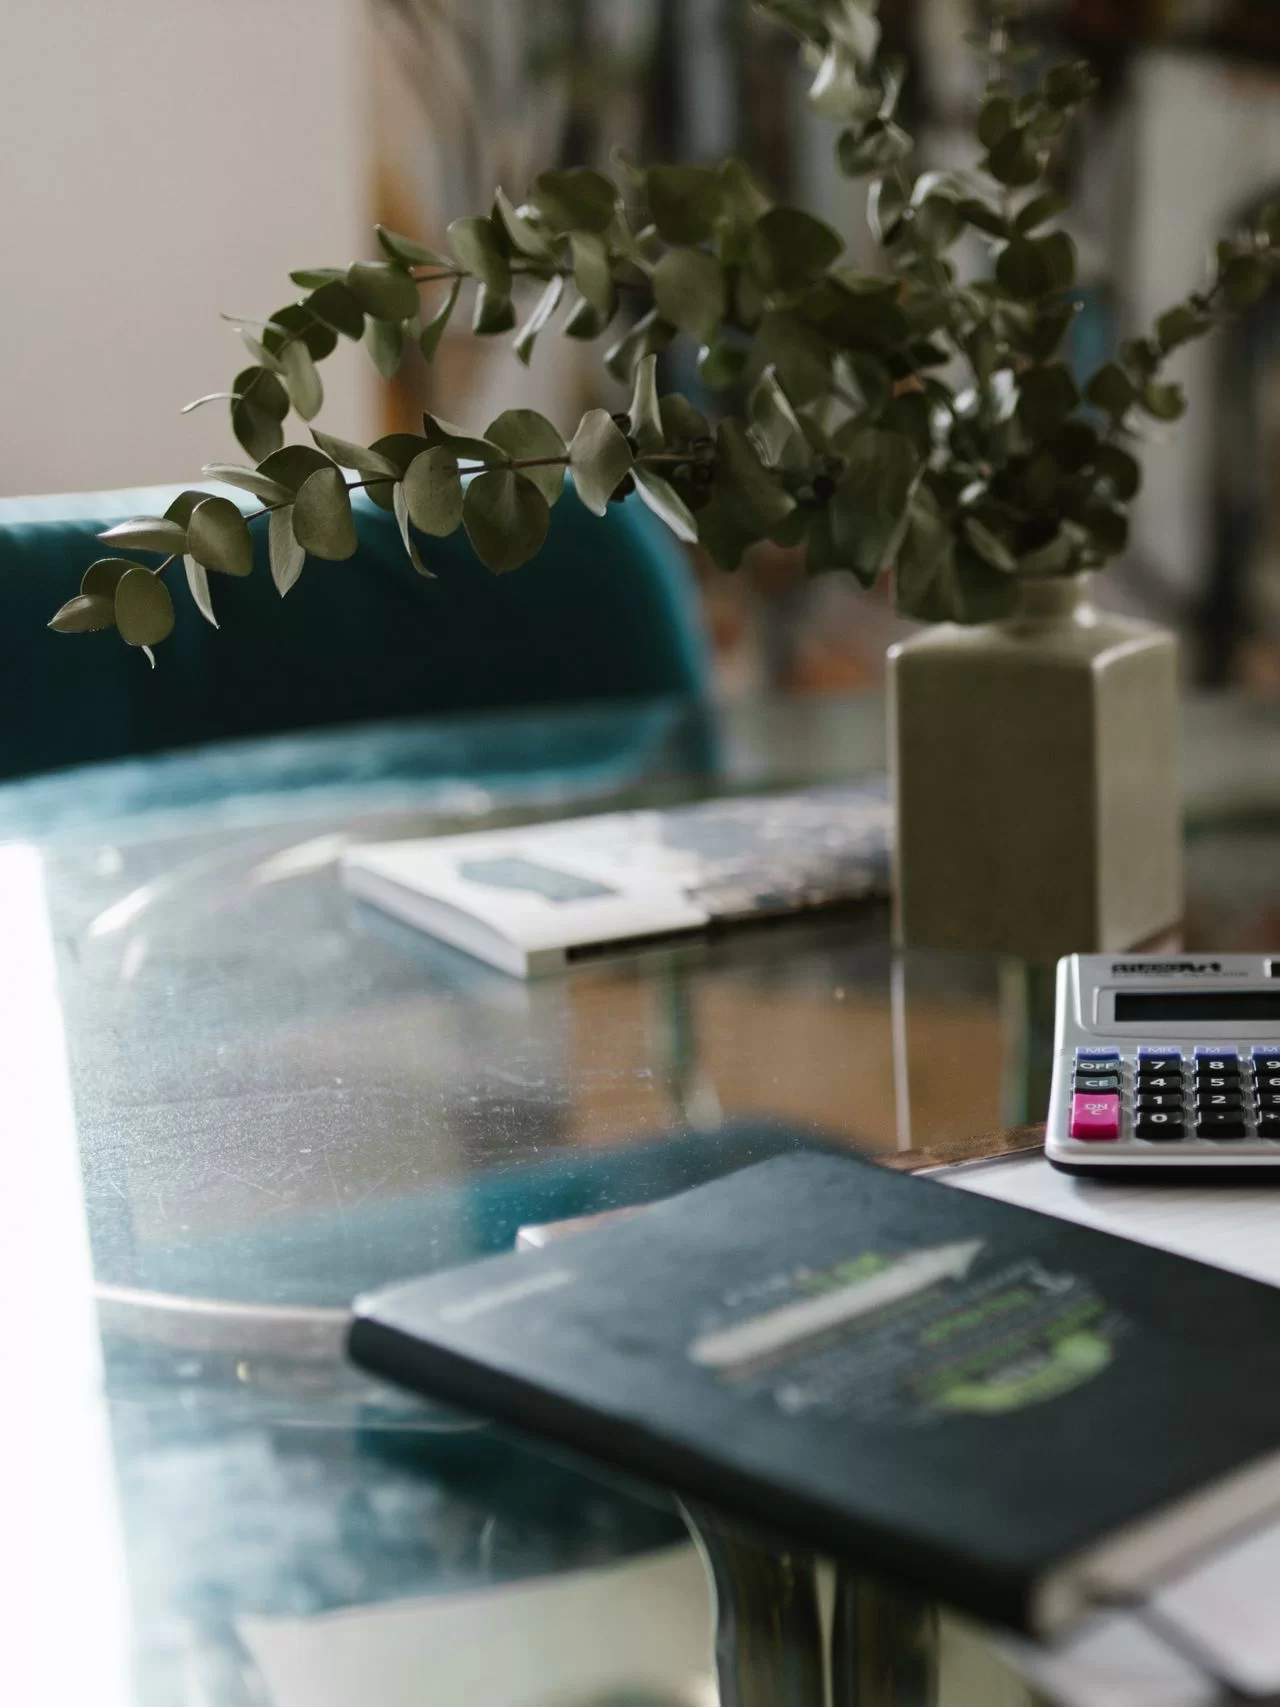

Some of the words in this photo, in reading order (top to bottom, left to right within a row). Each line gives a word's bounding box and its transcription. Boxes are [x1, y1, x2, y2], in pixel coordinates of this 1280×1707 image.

[1080, 1062, 1115, 1070] OFF
[1151, 1061, 1165, 1069] 7
[1209, 1061, 1224, 1069] 8
[1266, 1061, 1280, 1069] 9
[1150, 1078, 1166, 1086] 4
[1211, 1078, 1224, 1086] 5
[1153, 1096, 1163, 1104] 1
[1211, 1095, 1226, 1104] 2
[1151, 1113, 1167, 1123] 0
